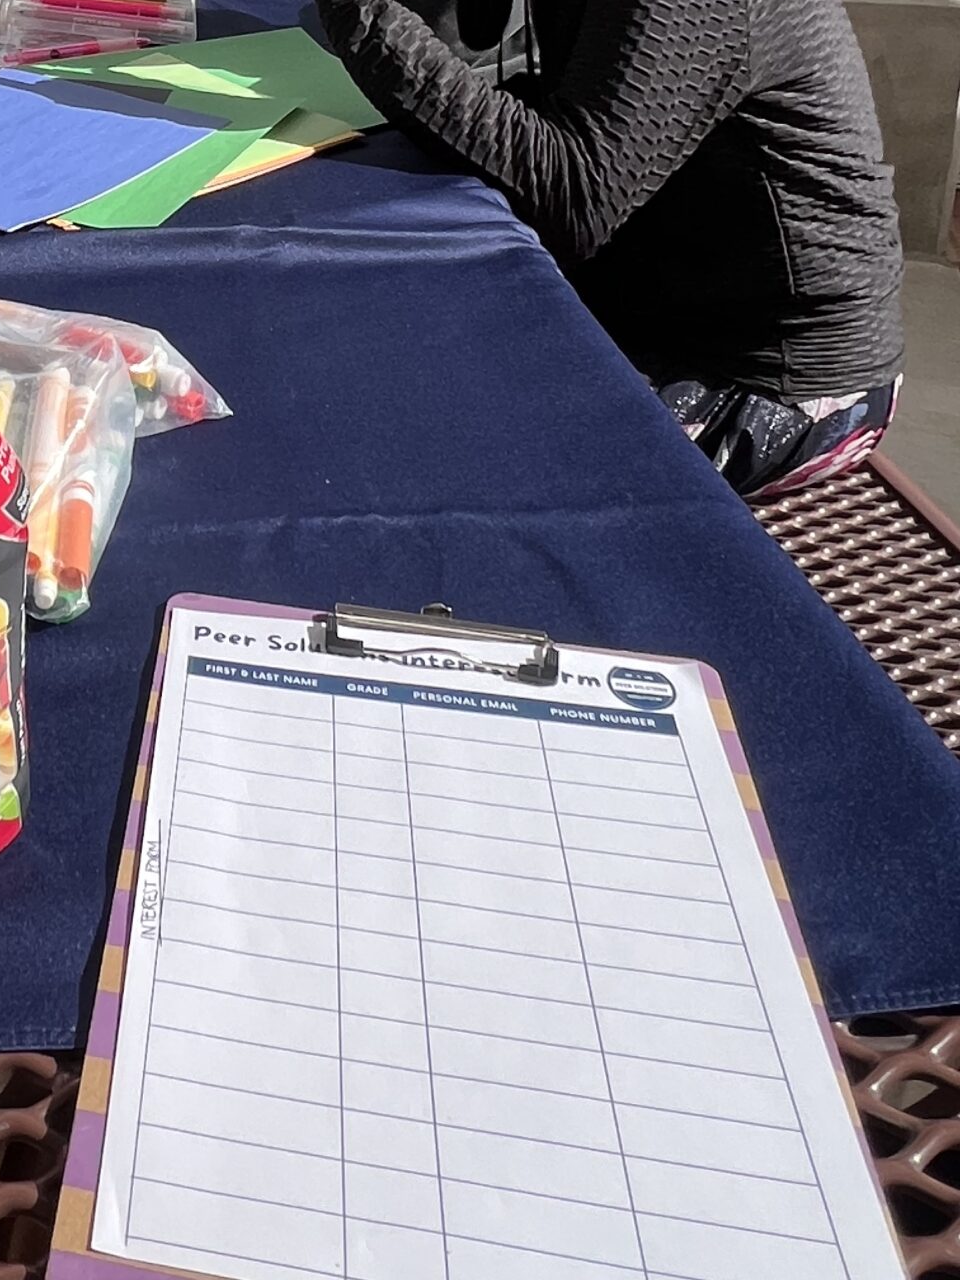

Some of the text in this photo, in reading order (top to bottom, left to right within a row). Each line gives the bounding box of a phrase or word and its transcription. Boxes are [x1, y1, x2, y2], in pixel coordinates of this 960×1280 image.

[194, 625, 257, 647] Peer
[205, 664, 237, 675] FIRST
[252, 671, 280, 682] LAST
[283, 675, 319, 687] NAME
[346, 682, 389, 695] GRADE
[413, 690, 477, 708] PERSONAL
[480, 697, 518, 712] EMAIL
[549, 707, 596, 722] PHONE
[599, 713, 657, 728] NUMBER
[140, 879, 159, 940] INTEREST
